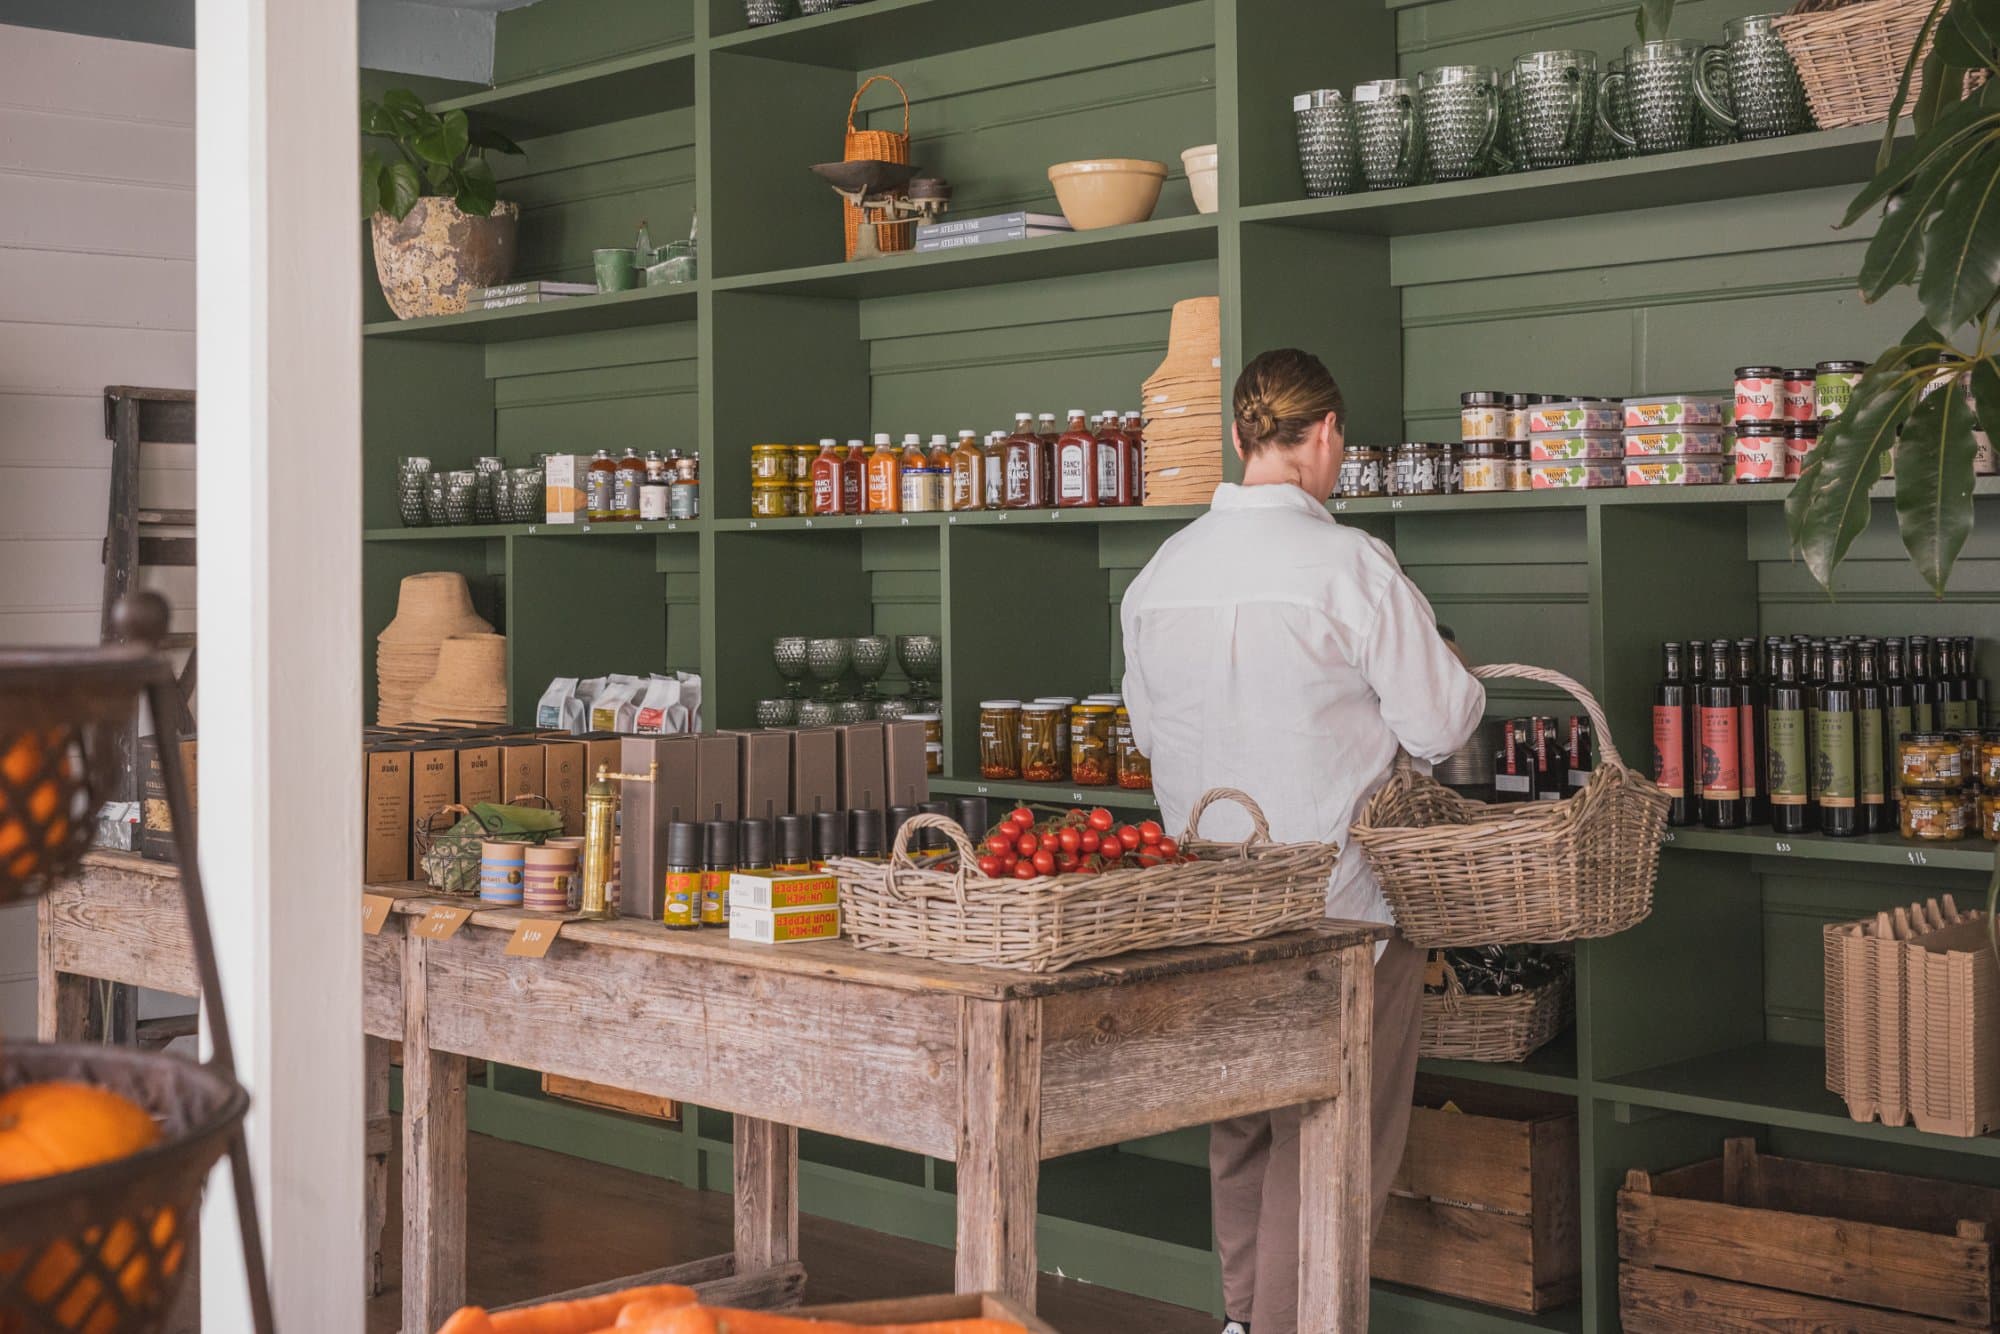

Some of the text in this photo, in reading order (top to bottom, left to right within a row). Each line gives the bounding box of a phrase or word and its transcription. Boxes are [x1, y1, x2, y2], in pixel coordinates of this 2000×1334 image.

[940, 223, 964, 234] ATELIER
[940, 237, 964, 248] ATELIER
[1818, 393, 1850, 404] HORE
[1641, 408, 1664, 416] HONEY
[1641, 437, 1664, 445] HONEY
[1546, 443, 1567, 451] HONEY
[1007, 461, 1028, 471] FANCY
[1064, 460, 1081, 469] FANCY
[1546, 471, 1568, 479] HONEY
[1643, 467, 1665, 475] HONEY
[774, 881, 810, 894] PEPPER
[776, 914, 811, 927] PEPPER
